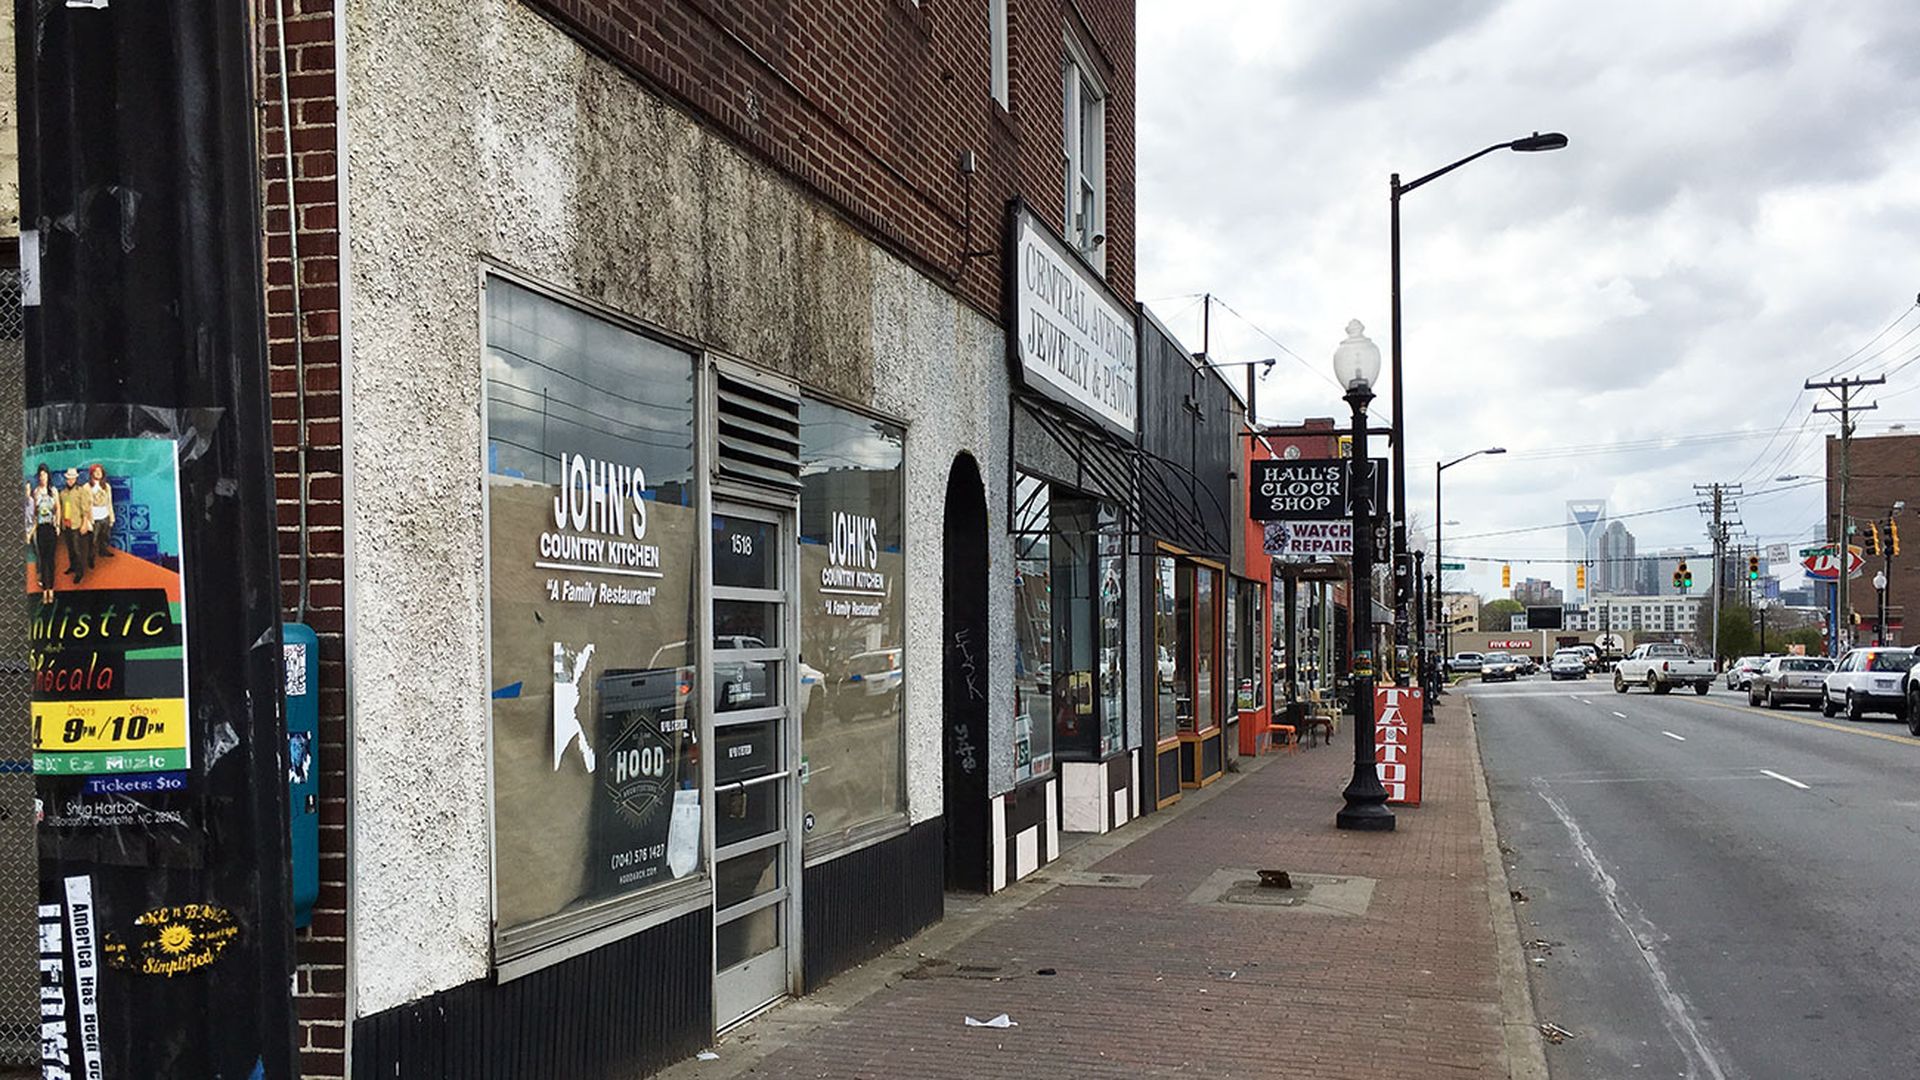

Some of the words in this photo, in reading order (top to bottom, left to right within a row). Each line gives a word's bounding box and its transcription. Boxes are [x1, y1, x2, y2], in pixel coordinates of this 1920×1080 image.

[1026, 242, 1088, 336] CENTRAL
[1091, 306, 1134, 372] AVENUE
[1027, 307, 1089, 391] JEWELRY
[1092, 357, 1101, 399] &
[1103, 365, 1134, 419] PAWN
[1264, 466, 1341, 481] HALL'S
[554, 452, 647, 540] JOHN'S
[1260, 482, 1341, 496] CLOCK
[1270, 496, 1331, 511] SHOP
[828, 511, 877, 570] JOHN'S
[1292, 524, 1351, 537] WATCH
[540, 532, 605, 562] COUNTRY
[608, 540, 660, 568] KITCHEN
[731, 533, 753, 556] 1518
[1290, 540, 1352, 552] REPAIR
[822, 567, 856, 587] COUNTRY
[856, 571, 884, 589] KITCHEN
[562, 580, 597, 608] Family
[833, 602, 850, 618] Family
[1509, 640, 1531, 648] GUYS
[67, 704, 96, 716] Doors
[129, 703, 160, 715] Show
[1375, 688, 1409, 800] TATTOO
[616, 746, 664, 784] HOOD
[89, 778, 153, 793] Tickets:
[156, 776, 182, 790] $10
[94, 801, 139, 816] Harbor
[611, 850, 633, 870] (704)
[649, 843, 665, 860] 1427
[72, 902, 93, 969] America
[143, 947, 213, 978] Simplified
[80, 976, 95, 1007] Has
[83, 1013, 98, 1052] Been
